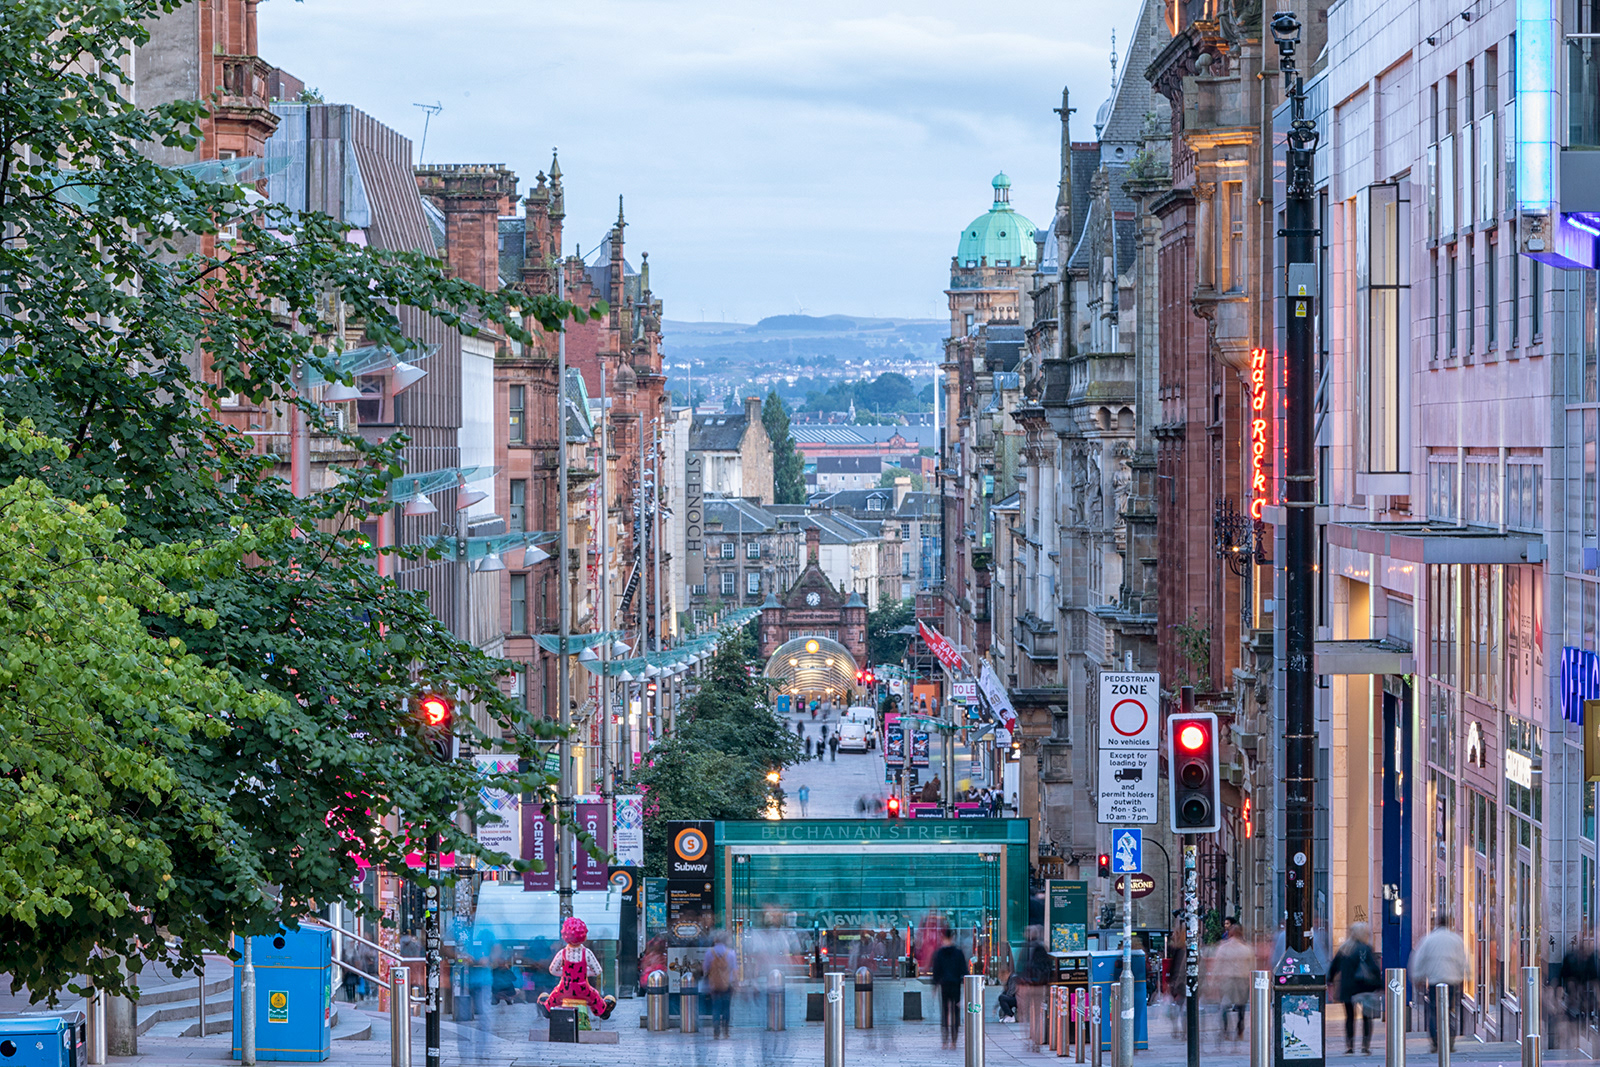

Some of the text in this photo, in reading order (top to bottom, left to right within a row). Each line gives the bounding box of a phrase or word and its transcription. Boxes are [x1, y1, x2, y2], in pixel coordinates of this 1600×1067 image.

[1251, 347, 1267, 411] Hard
[1251, 418, 1267, 493] Rock
[687, 458, 702, 552] ST ENOCH
[931, 642, 950, 664] SALE
[939, 641, 961, 664] SALE
[1104, 675, 1155, 683] PEDESTRIAN
[953, 685, 976, 694] TO LE
[1111, 684, 1148, 695] ZONE
[1107, 738, 1150, 746] No vehicles
[1109, 752, 1135, 760] Except
[1138, 760, 1147, 768] by
[1101, 791, 1125, 799] permit
[761, 825, 974, 839] BUCHANAN STREET
[534, 821, 544, 862] CENTR
[687, 839, 695, 850] S
[674, 862, 708, 873] Subway
[1117, 881, 1154, 889] AARONE
